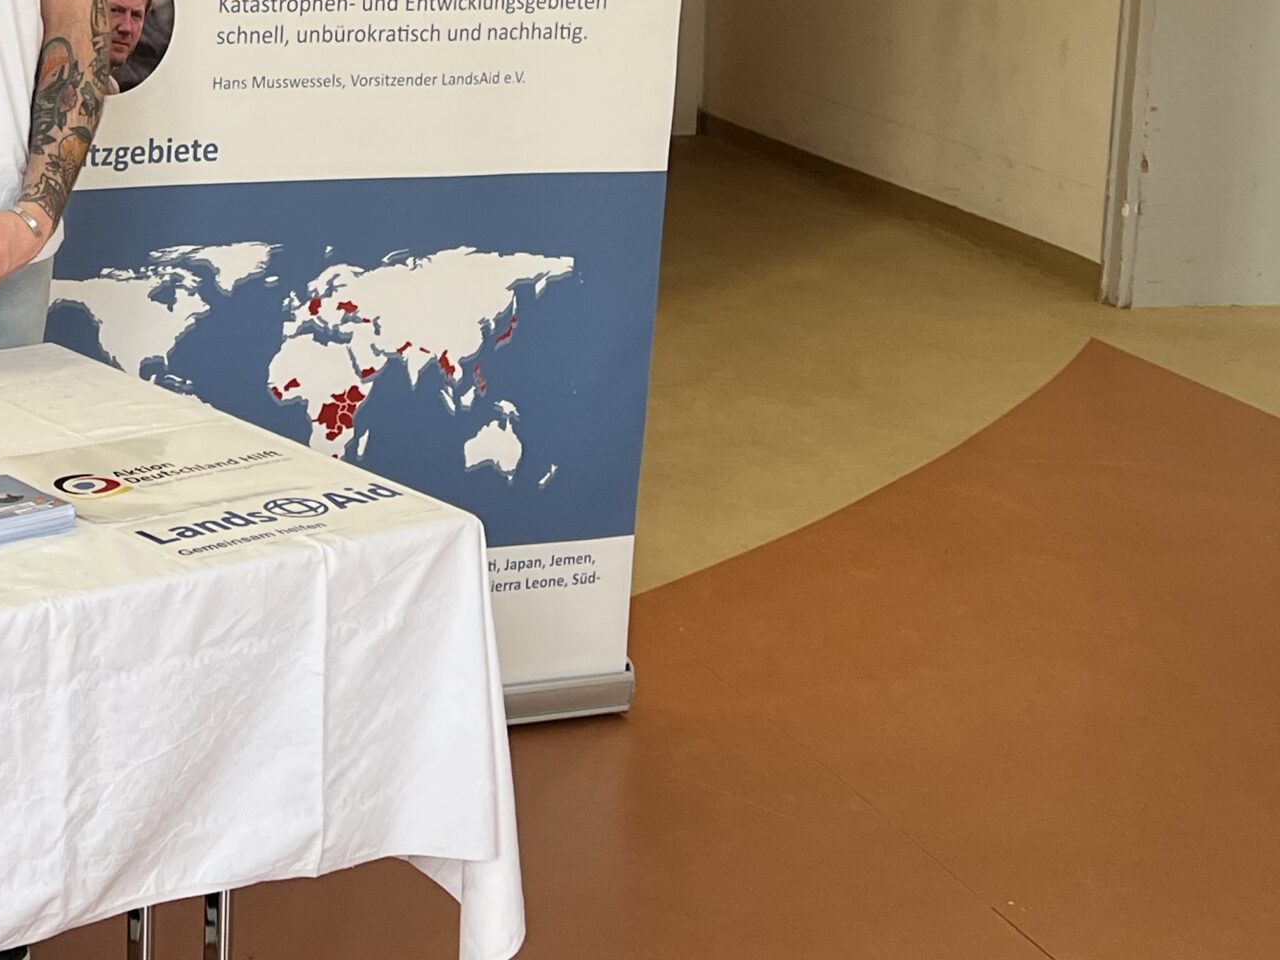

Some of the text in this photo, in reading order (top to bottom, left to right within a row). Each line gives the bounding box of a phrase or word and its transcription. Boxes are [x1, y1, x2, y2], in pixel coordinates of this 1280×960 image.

[216, 21, 588, 47] schnell, unbürokratisch und nachhaltig.
[213, 71, 526, 90] Hans Musswessels, Vorsitzender LandsAid e.V.
[82, 138, 218, 172] tzgebiete
[113, 462, 175, 478] Aktion
[124, 458, 237, 484] Deutschland
[239, 450, 283, 463] Hilft
[178, 522, 327, 556] Gemeinsam helfen
[504, 558, 546, 573] Japan,
[549, 554, 596, 567] Jemen,
[525, 576, 568, 589] Leone,
[572, 571, 601, 586] Süd-
